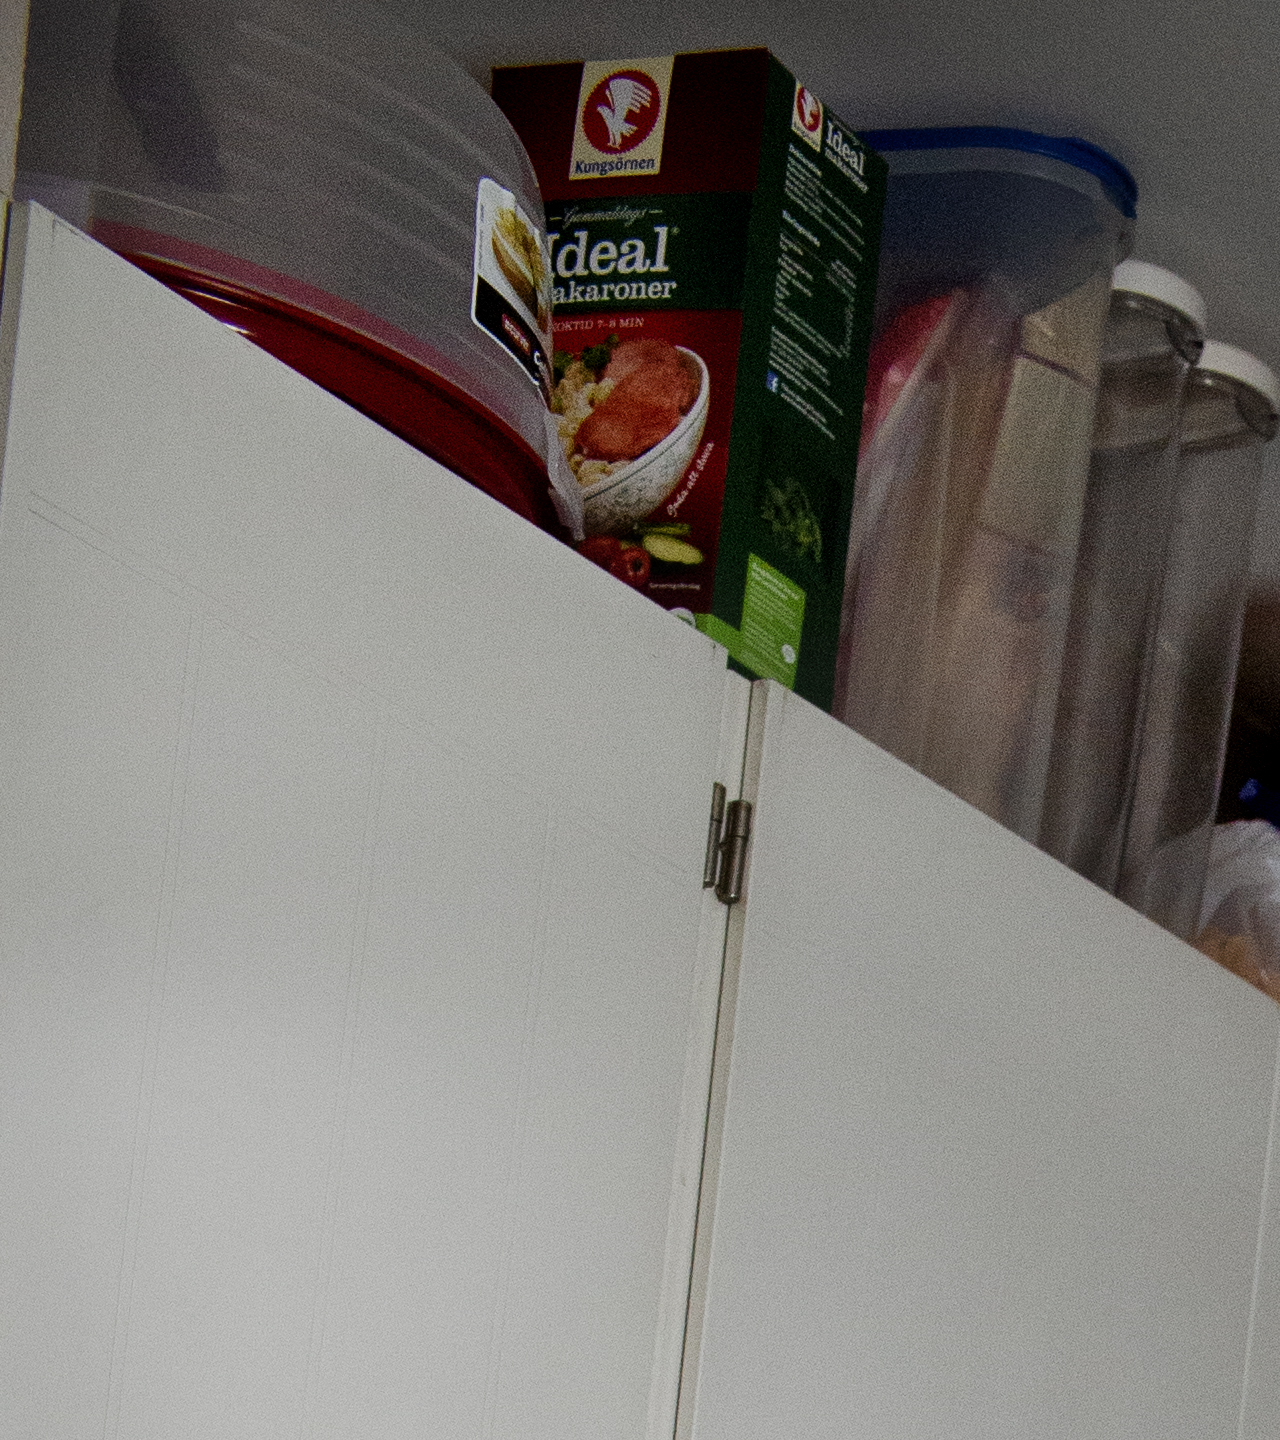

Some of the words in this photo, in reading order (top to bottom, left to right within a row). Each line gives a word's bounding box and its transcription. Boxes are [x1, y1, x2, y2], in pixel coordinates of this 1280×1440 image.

[826, 119, 867, 177] Ideal
[574, 157, 655, 175] Kungsörnen
[552, 280, 677, 304] akaroner
[619, 317, 644, 328] MIN
